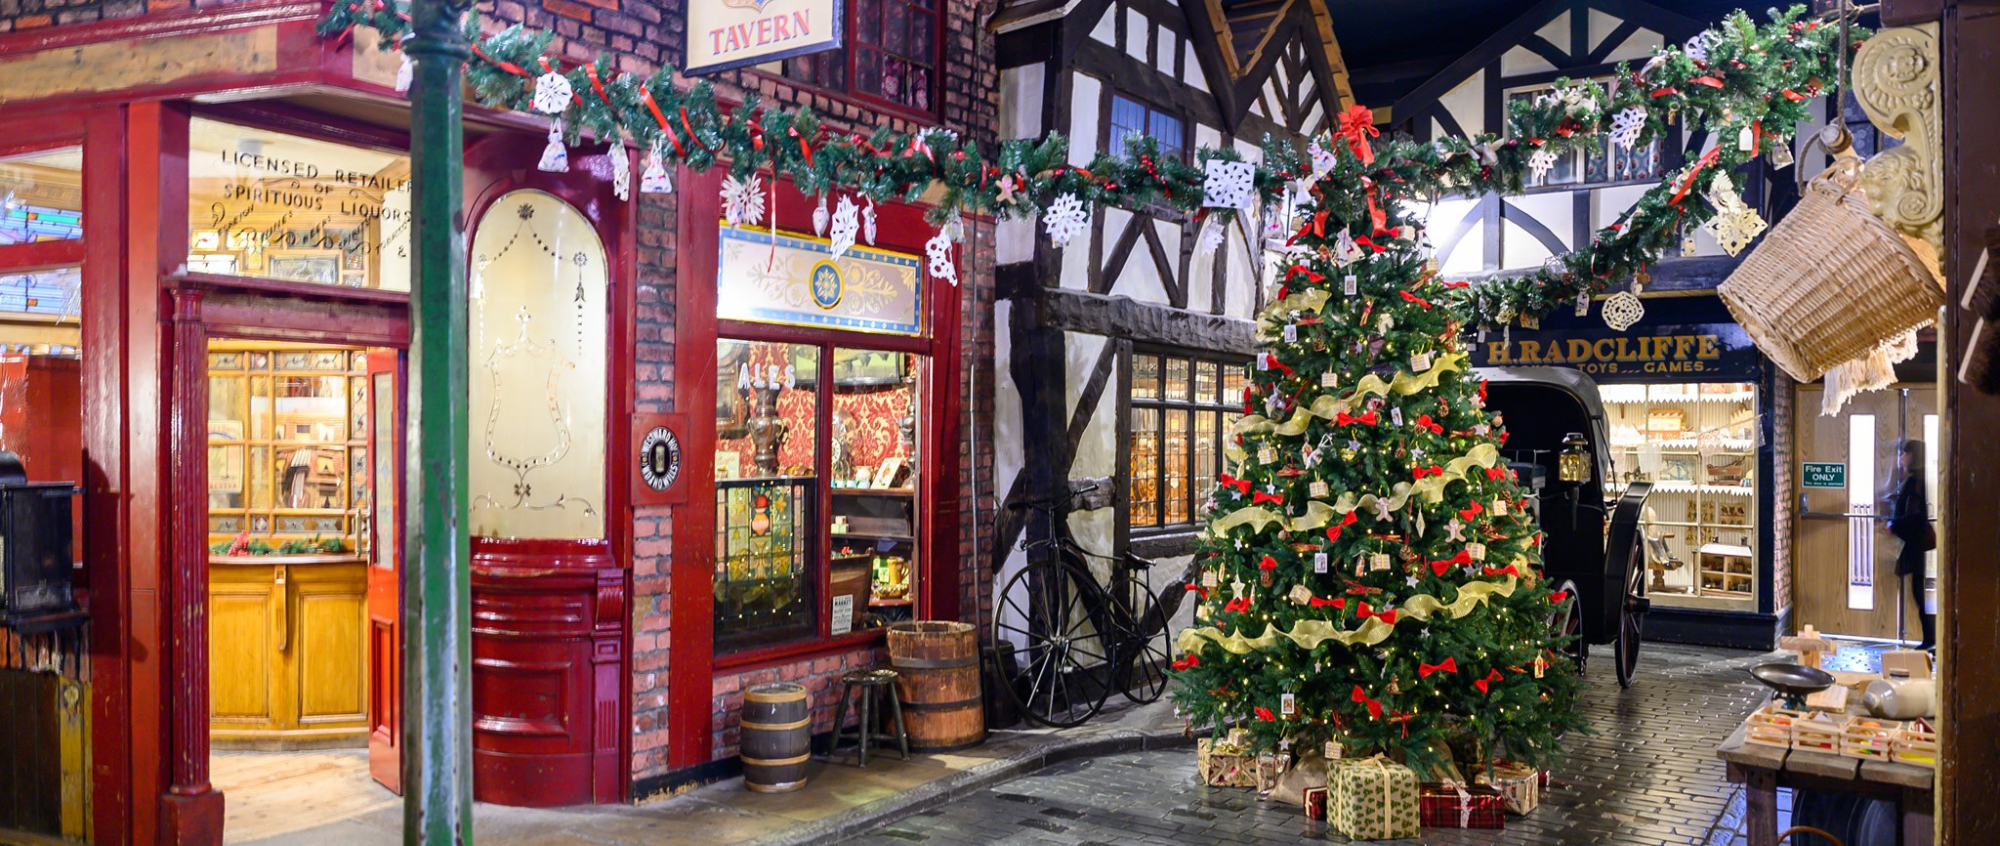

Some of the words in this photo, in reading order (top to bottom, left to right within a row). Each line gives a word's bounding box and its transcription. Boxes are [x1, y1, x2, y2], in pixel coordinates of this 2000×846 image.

[709, 8, 810, 55] TAVERN
[222, 149, 319, 179] LICENSED
[224, 183, 324, 211] SPIRITUOUS
[341, 201, 411, 223] LIQUORS
[314, 183, 334, 195] OF
[737, 362, 796, 390] ALES
[1812, 473, 1835, 481] ONLY
